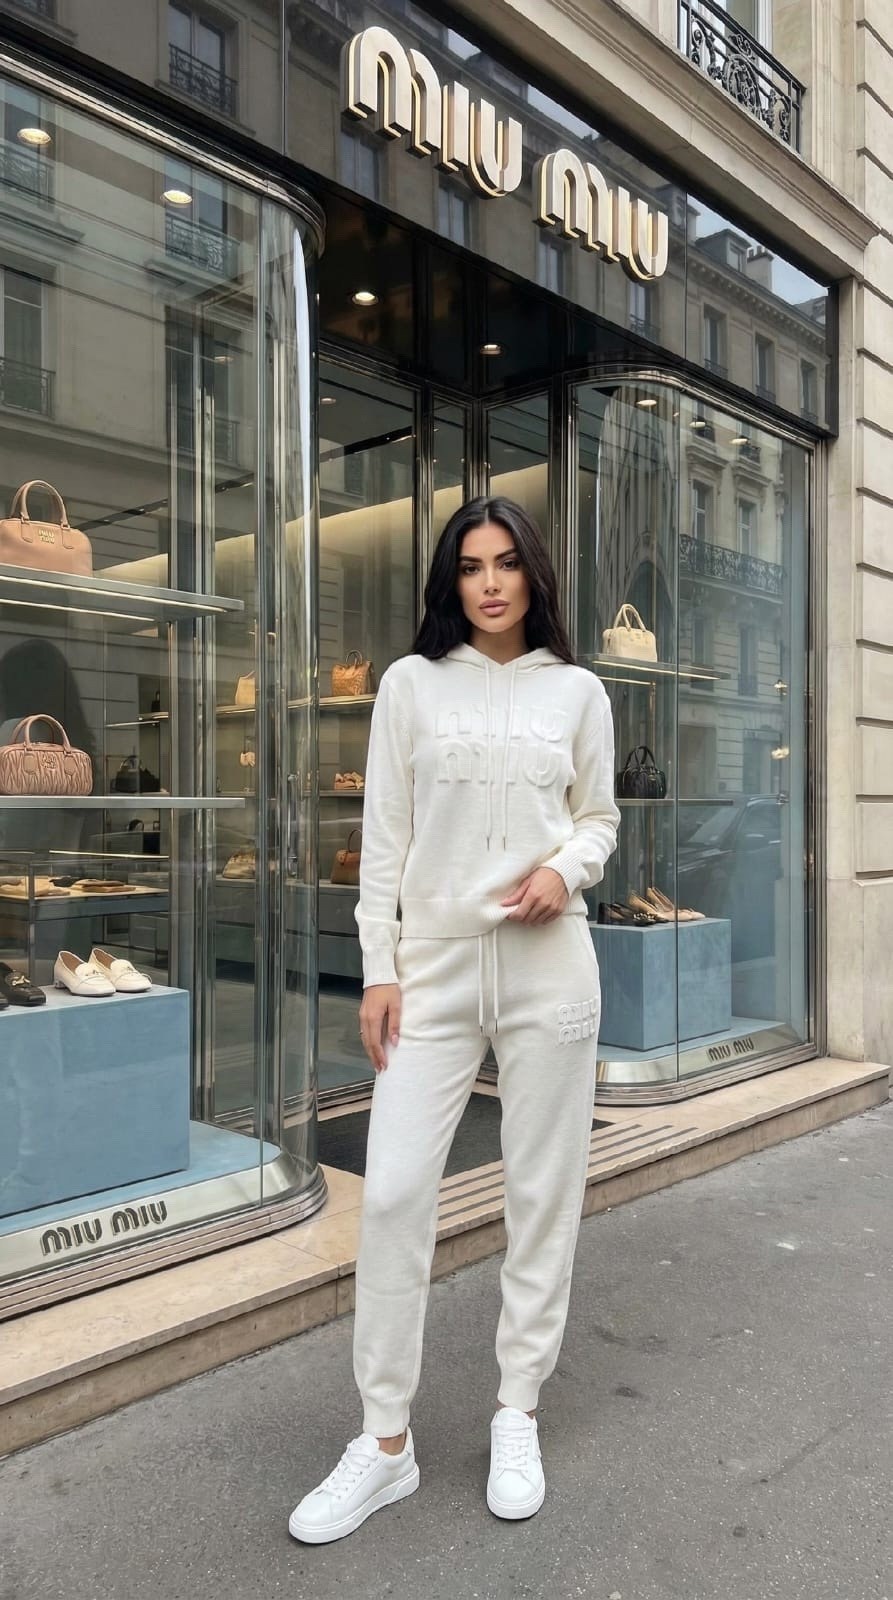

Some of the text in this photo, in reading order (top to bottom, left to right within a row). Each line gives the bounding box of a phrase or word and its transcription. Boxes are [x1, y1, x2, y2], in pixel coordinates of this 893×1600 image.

[346, 26, 669, 280] MIU MIU
[40, 1200, 168, 1256] MIU MIU
